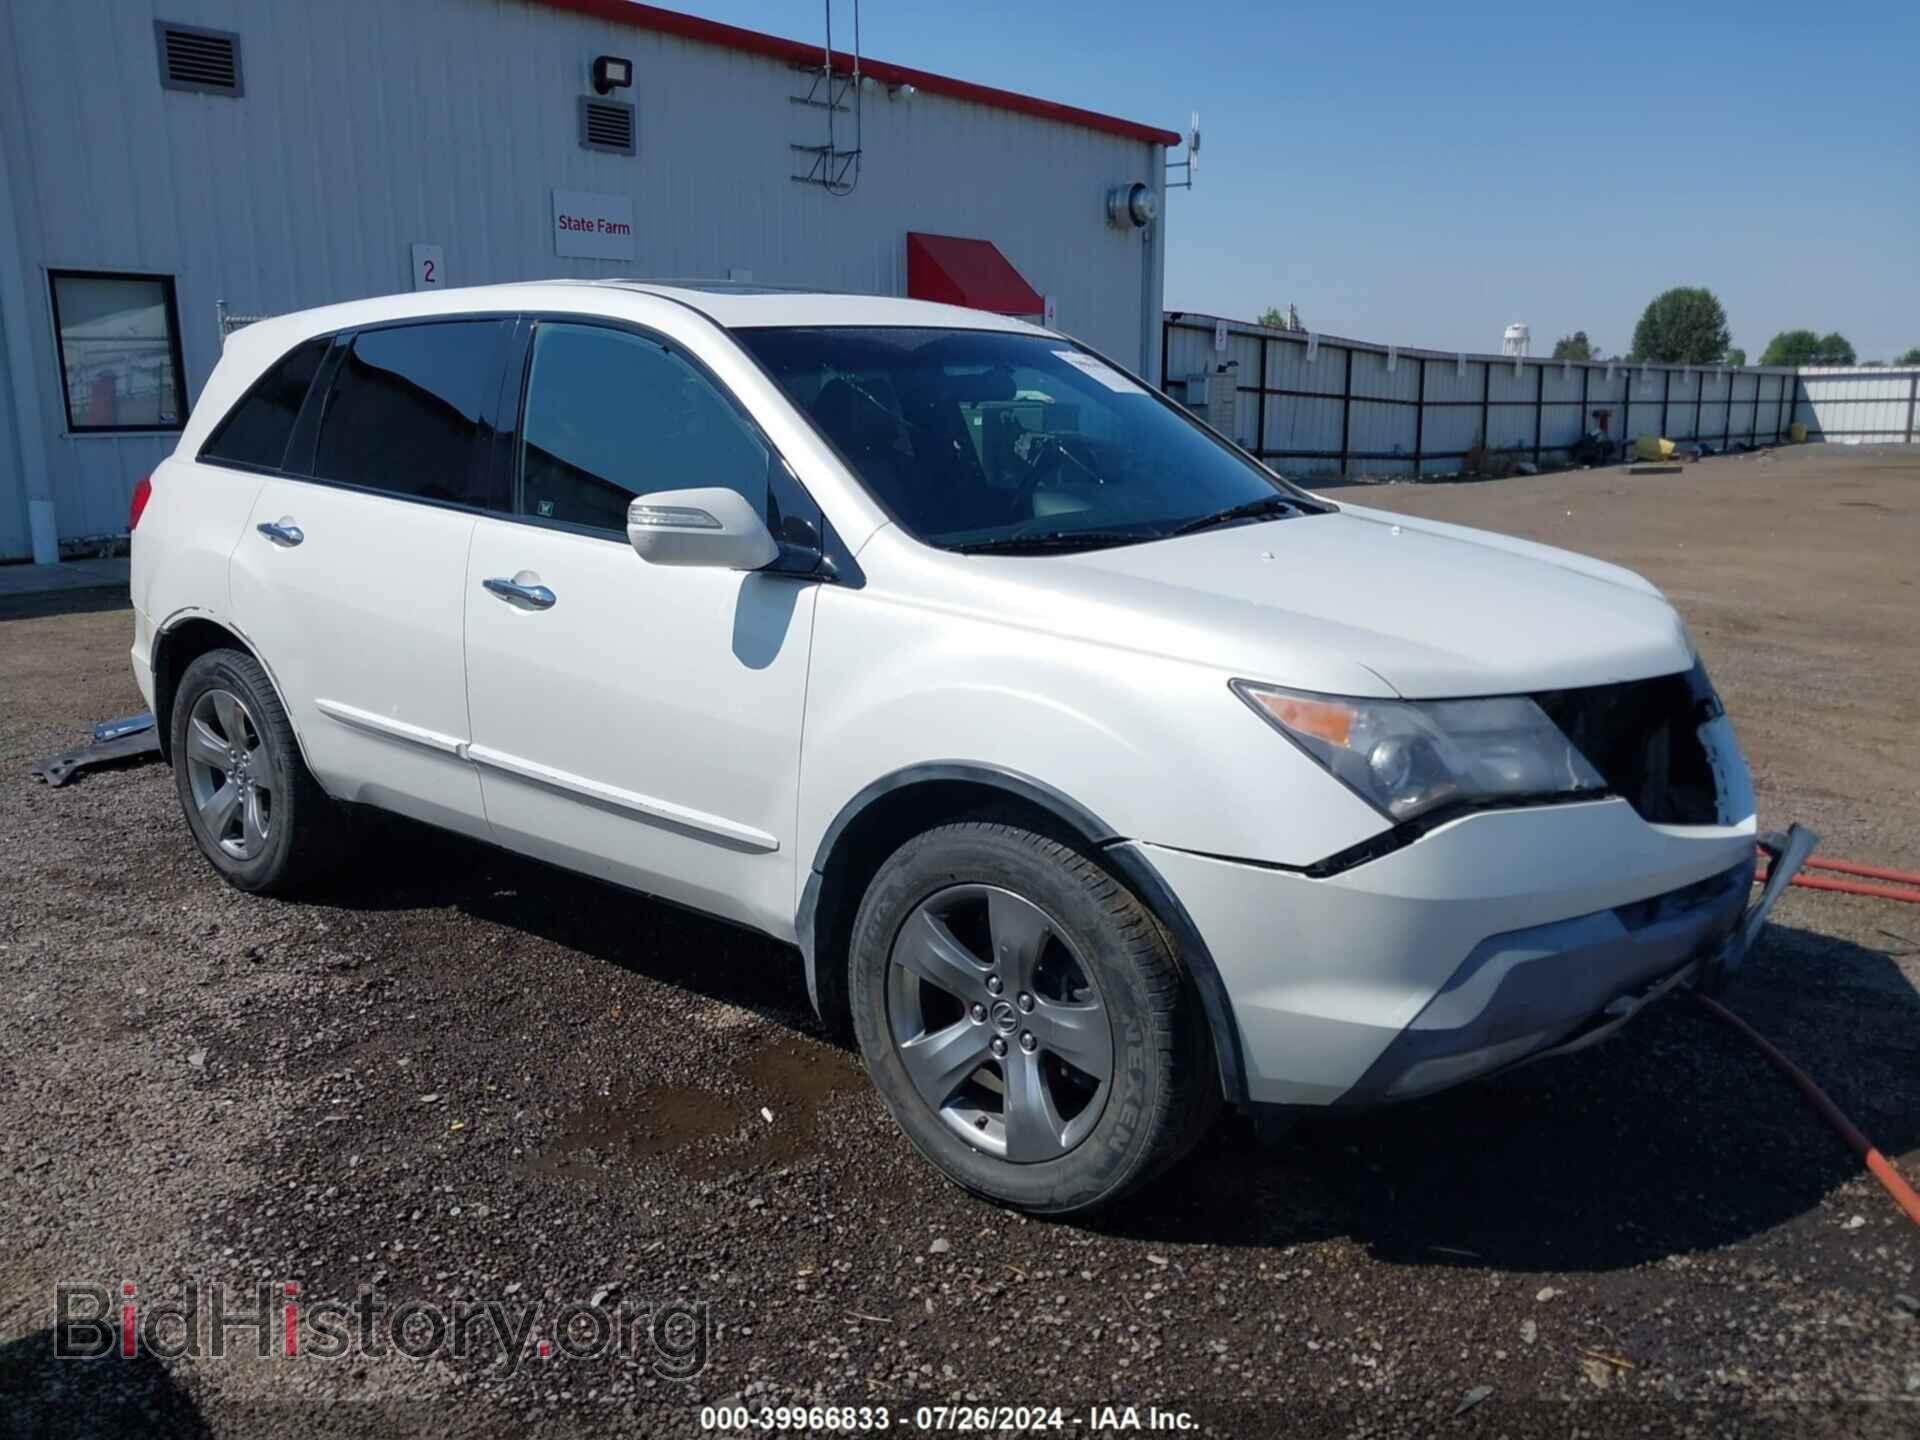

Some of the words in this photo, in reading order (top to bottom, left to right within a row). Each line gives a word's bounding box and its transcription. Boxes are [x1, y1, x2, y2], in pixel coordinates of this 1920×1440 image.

[559, 215, 594, 232] State
[597, 218, 631, 236] Farm
[423, 259, 436, 283] 2
[1106, 1022, 1146, 1154] NEXEN
